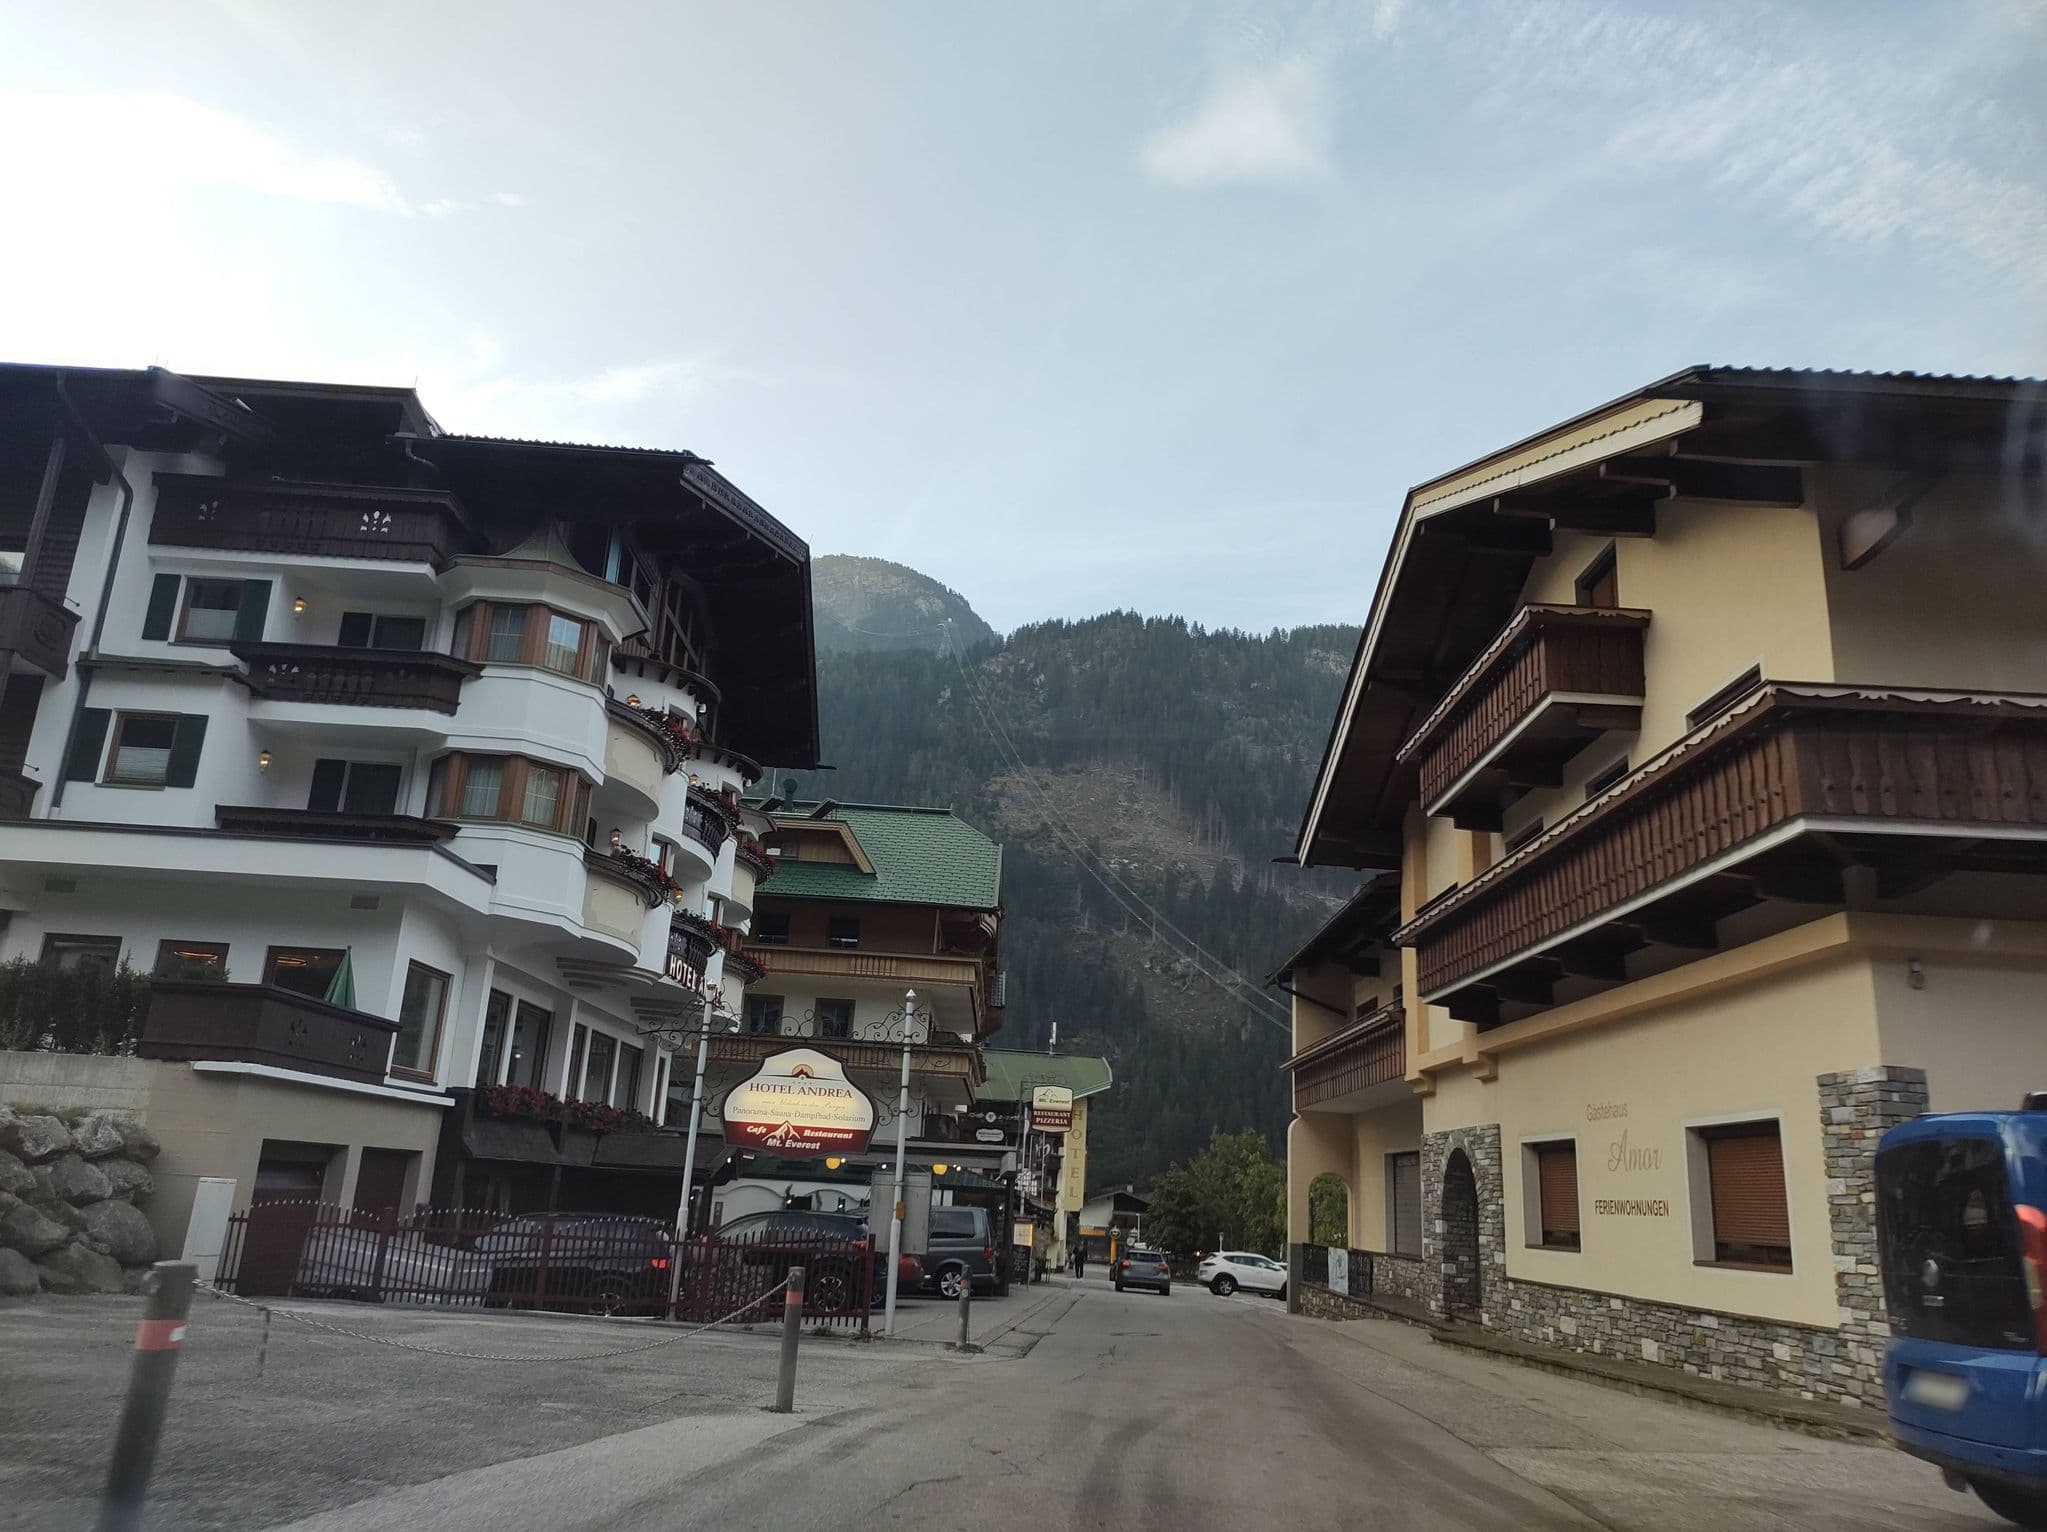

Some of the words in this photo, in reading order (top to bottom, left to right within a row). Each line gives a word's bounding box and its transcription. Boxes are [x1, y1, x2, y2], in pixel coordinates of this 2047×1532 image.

[669, 955, 697, 991] HOTEL
[749, 1083, 795, 1095] HOTEL
[798, 1086, 853, 1098] ANDREA
[803, 1129, 854, 1139] Restaurant
[766, 1138, 783, 1147] Mt.
[784, 1139, 821, 1150] Everest
[1608, 1128, 1661, 1172] Amor
[1069, 1110, 1083, 1198] HOTEL
[1594, 1199, 1670, 1216] FERIENWOHNUNGEN
